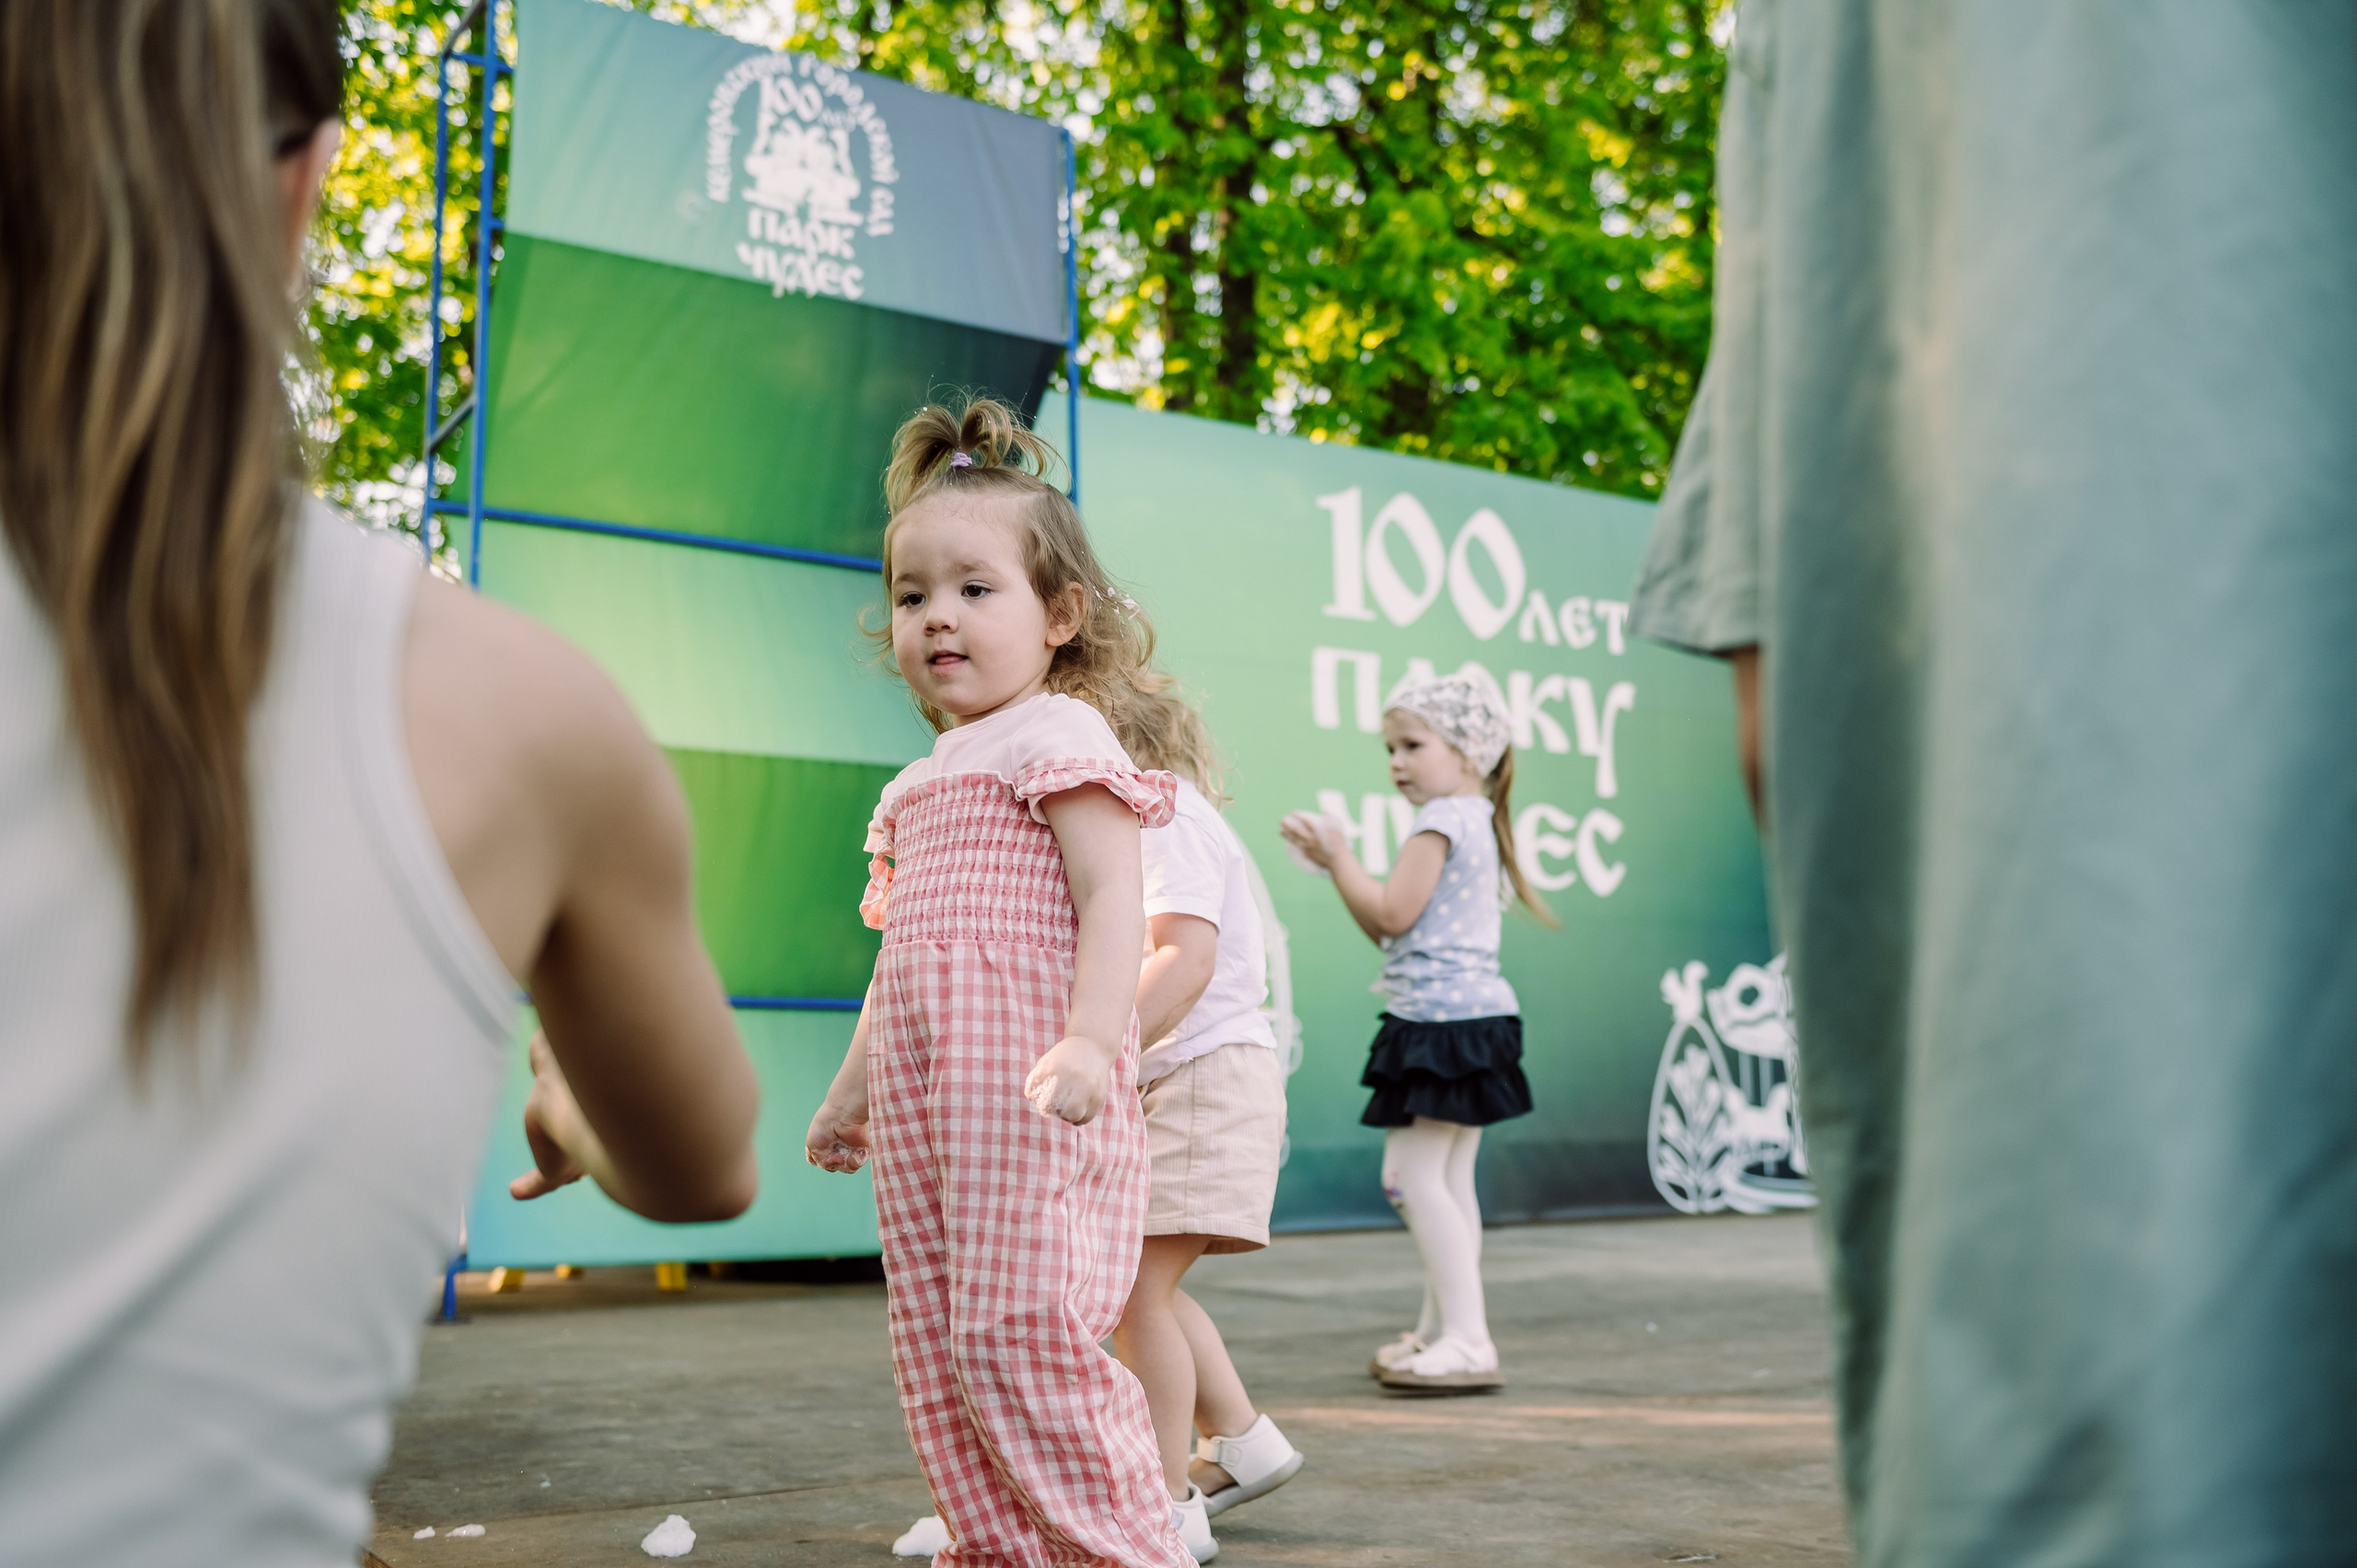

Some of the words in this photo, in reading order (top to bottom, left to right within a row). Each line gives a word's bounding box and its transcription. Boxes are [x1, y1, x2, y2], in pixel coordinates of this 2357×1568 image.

[756, 74, 824, 122] 100
[1315, 485, 1527, 641] 100
[1518, 589, 1630, 656] лет
[1311, 645, 1636, 799] ПКУ
